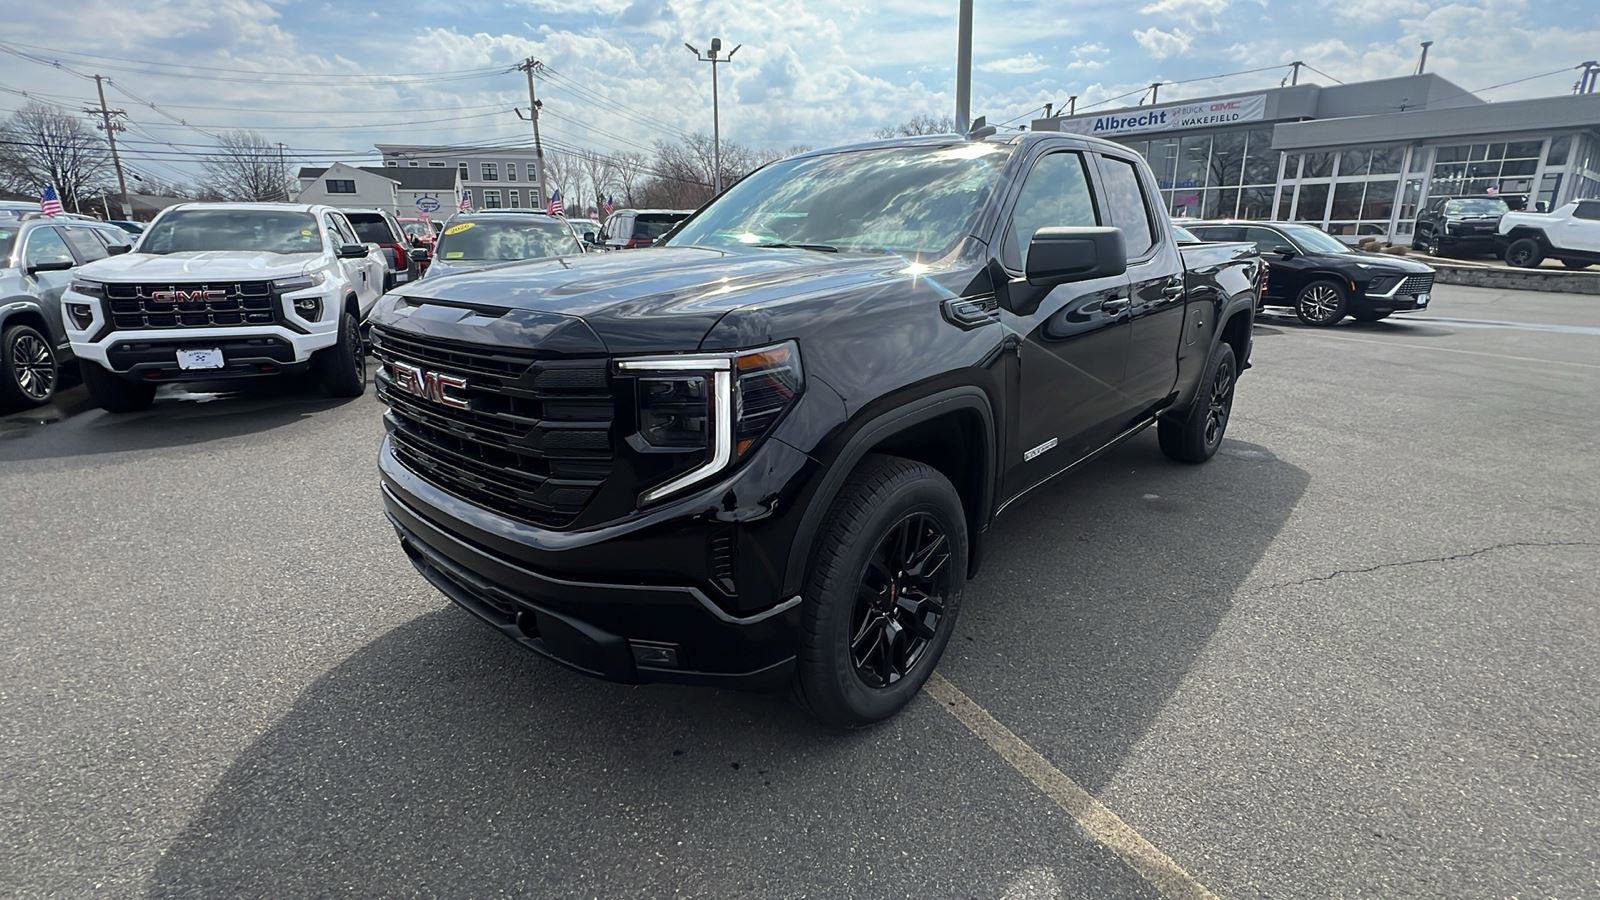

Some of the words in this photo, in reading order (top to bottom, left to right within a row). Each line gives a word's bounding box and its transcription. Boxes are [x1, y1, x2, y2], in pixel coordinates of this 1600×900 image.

[1182, 106, 1203, 115] BUICK
[1210, 102, 1241, 112] GMC
[1093, 111, 1167, 131] Albrecht
[1181, 113, 1239, 126] WAKEFIELD
[151, 289, 228, 303] GMC
[392, 361, 471, 411] GMC
